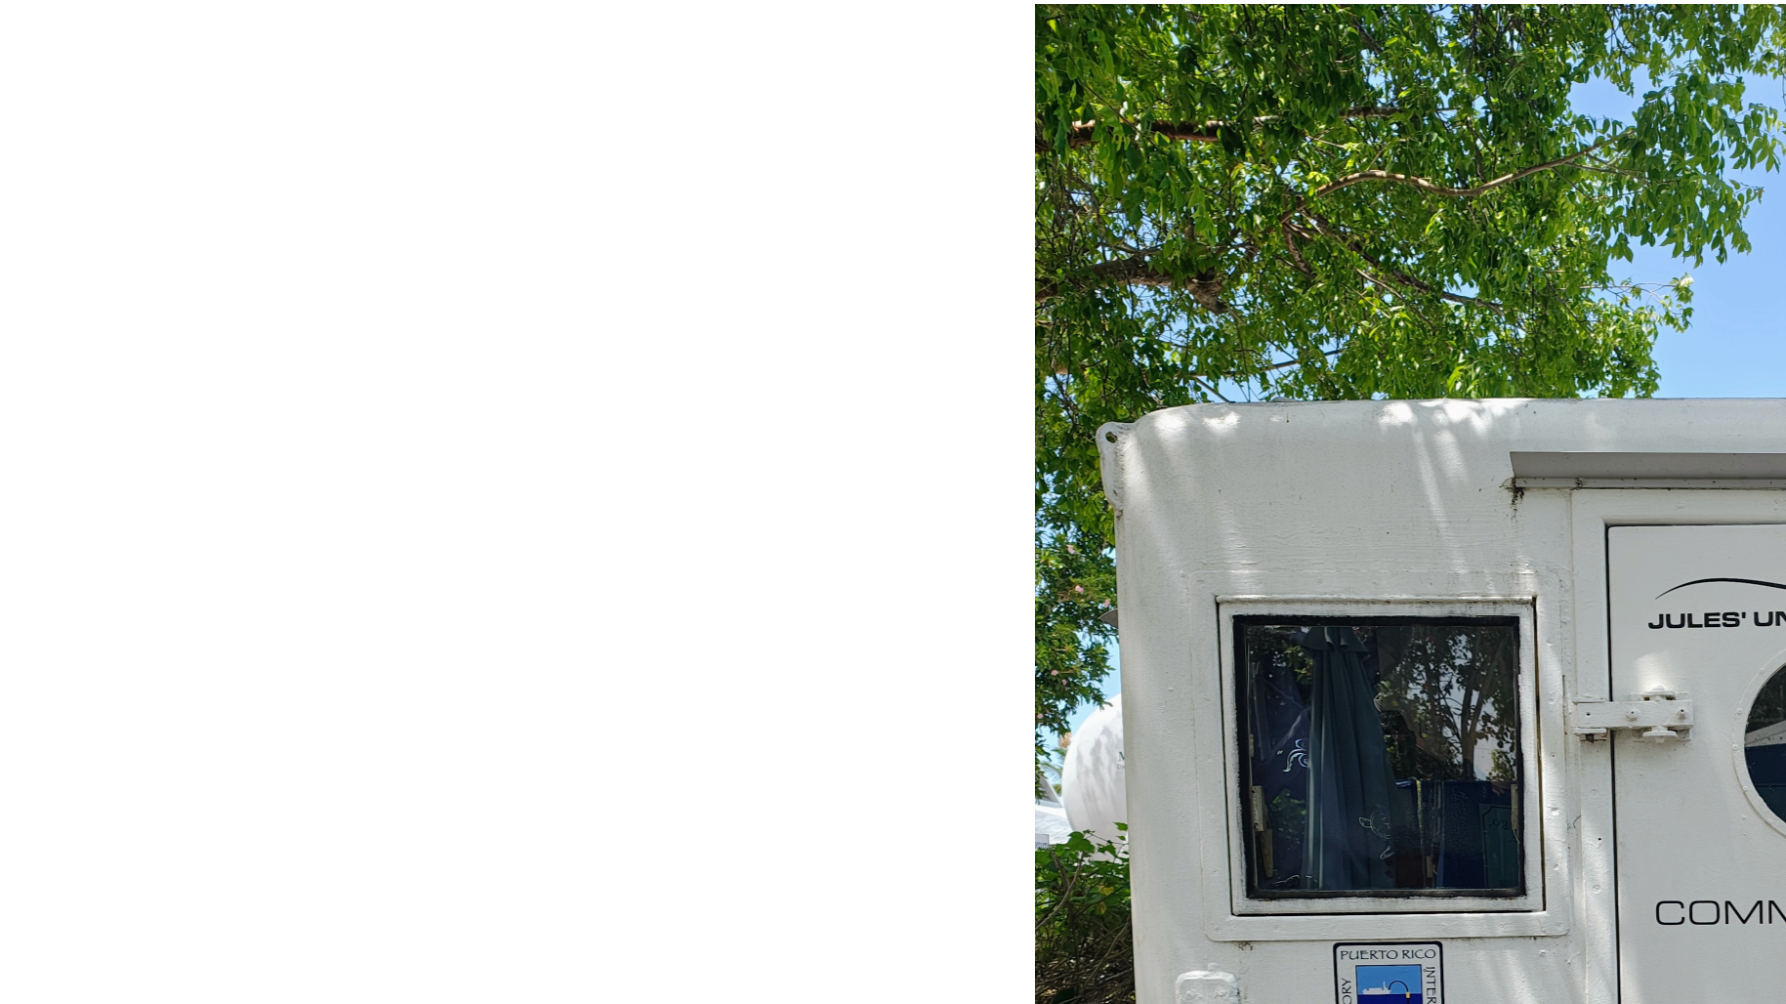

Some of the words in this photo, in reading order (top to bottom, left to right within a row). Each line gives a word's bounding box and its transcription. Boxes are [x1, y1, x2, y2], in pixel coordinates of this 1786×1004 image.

[1647, 611, 1747, 630] JULES'
[1340, 949, 1399, 961] PUERTO
[1402, 948, 1437, 960] RICO
